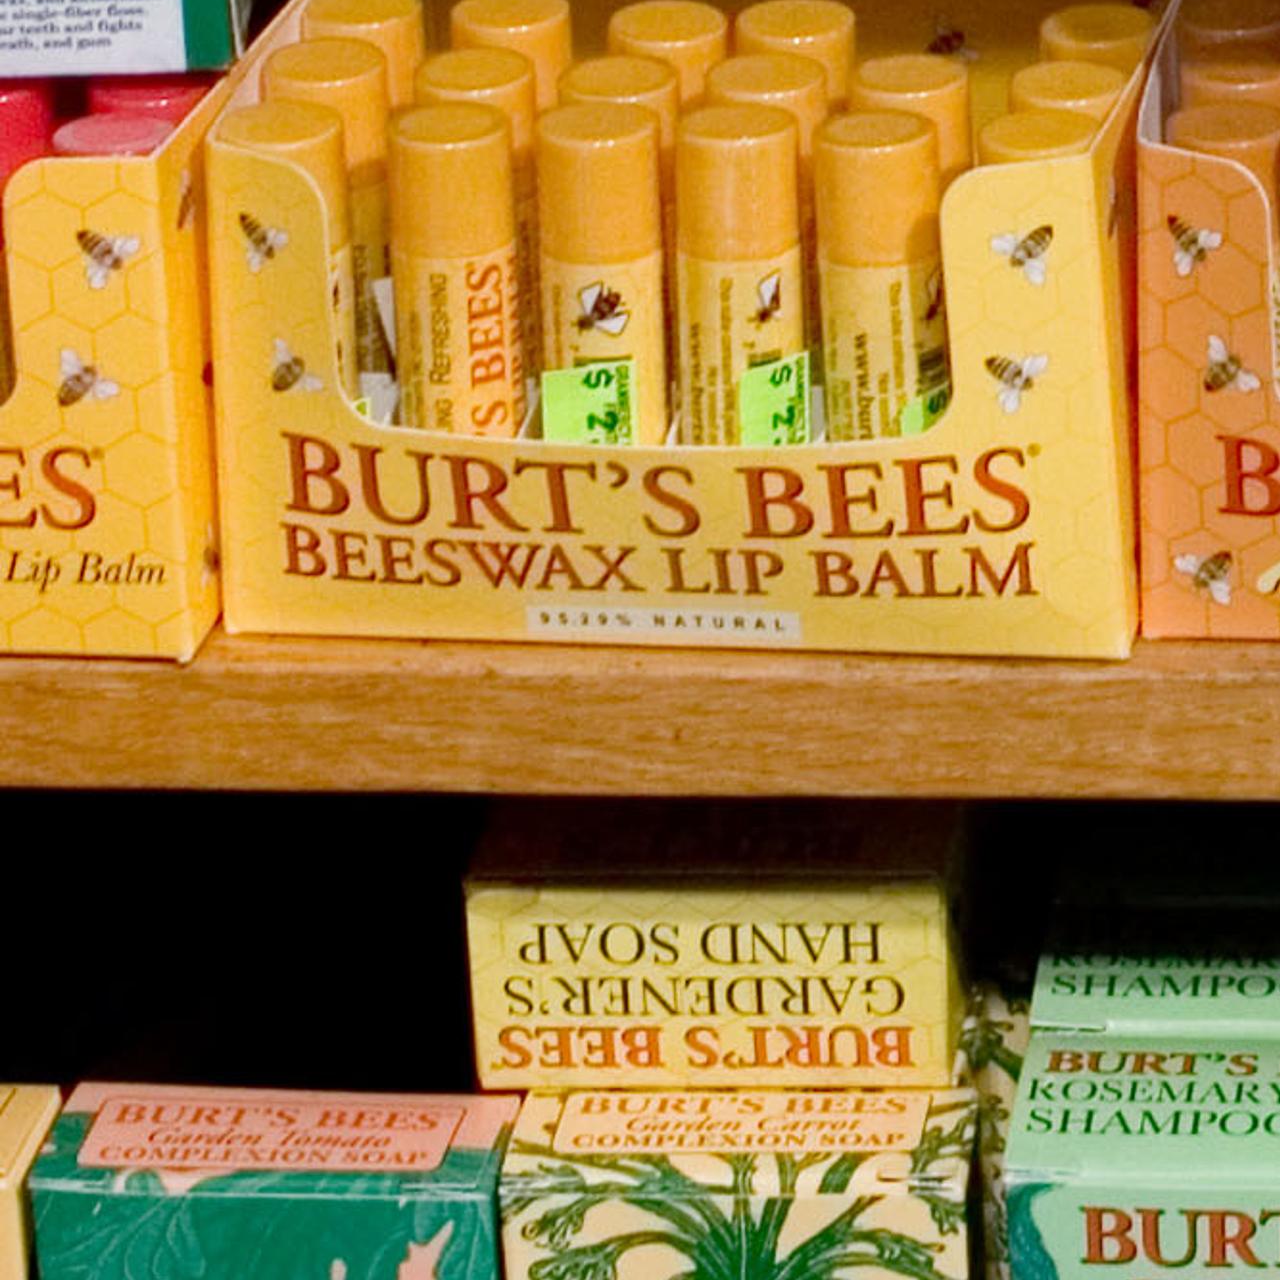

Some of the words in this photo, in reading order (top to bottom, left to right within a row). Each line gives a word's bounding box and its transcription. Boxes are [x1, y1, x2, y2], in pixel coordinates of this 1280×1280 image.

[284, 434, 703, 539] BURT'S
[739, 448, 1035, 537] BEES
[6, 551, 61, 593] Lip
[78, 551, 166, 584] Balm
[284, 523, 641, 591] BEESWAX
[666, 543, 786, 596] LIP
[813, 543, 1038, 598] BALM
[654, 613, 786, 631] NATURAL
[520, 921, 680, 966] SOAP
[699, 922, 883, 964] HAND
[503, 976, 905, 1017] GARDENER'S
[497, 1023, 665, 1070] BEES
[685, 1023, 915, 1069] BURT'S
[1046, 1050, 1259, 1076] BURT'S
